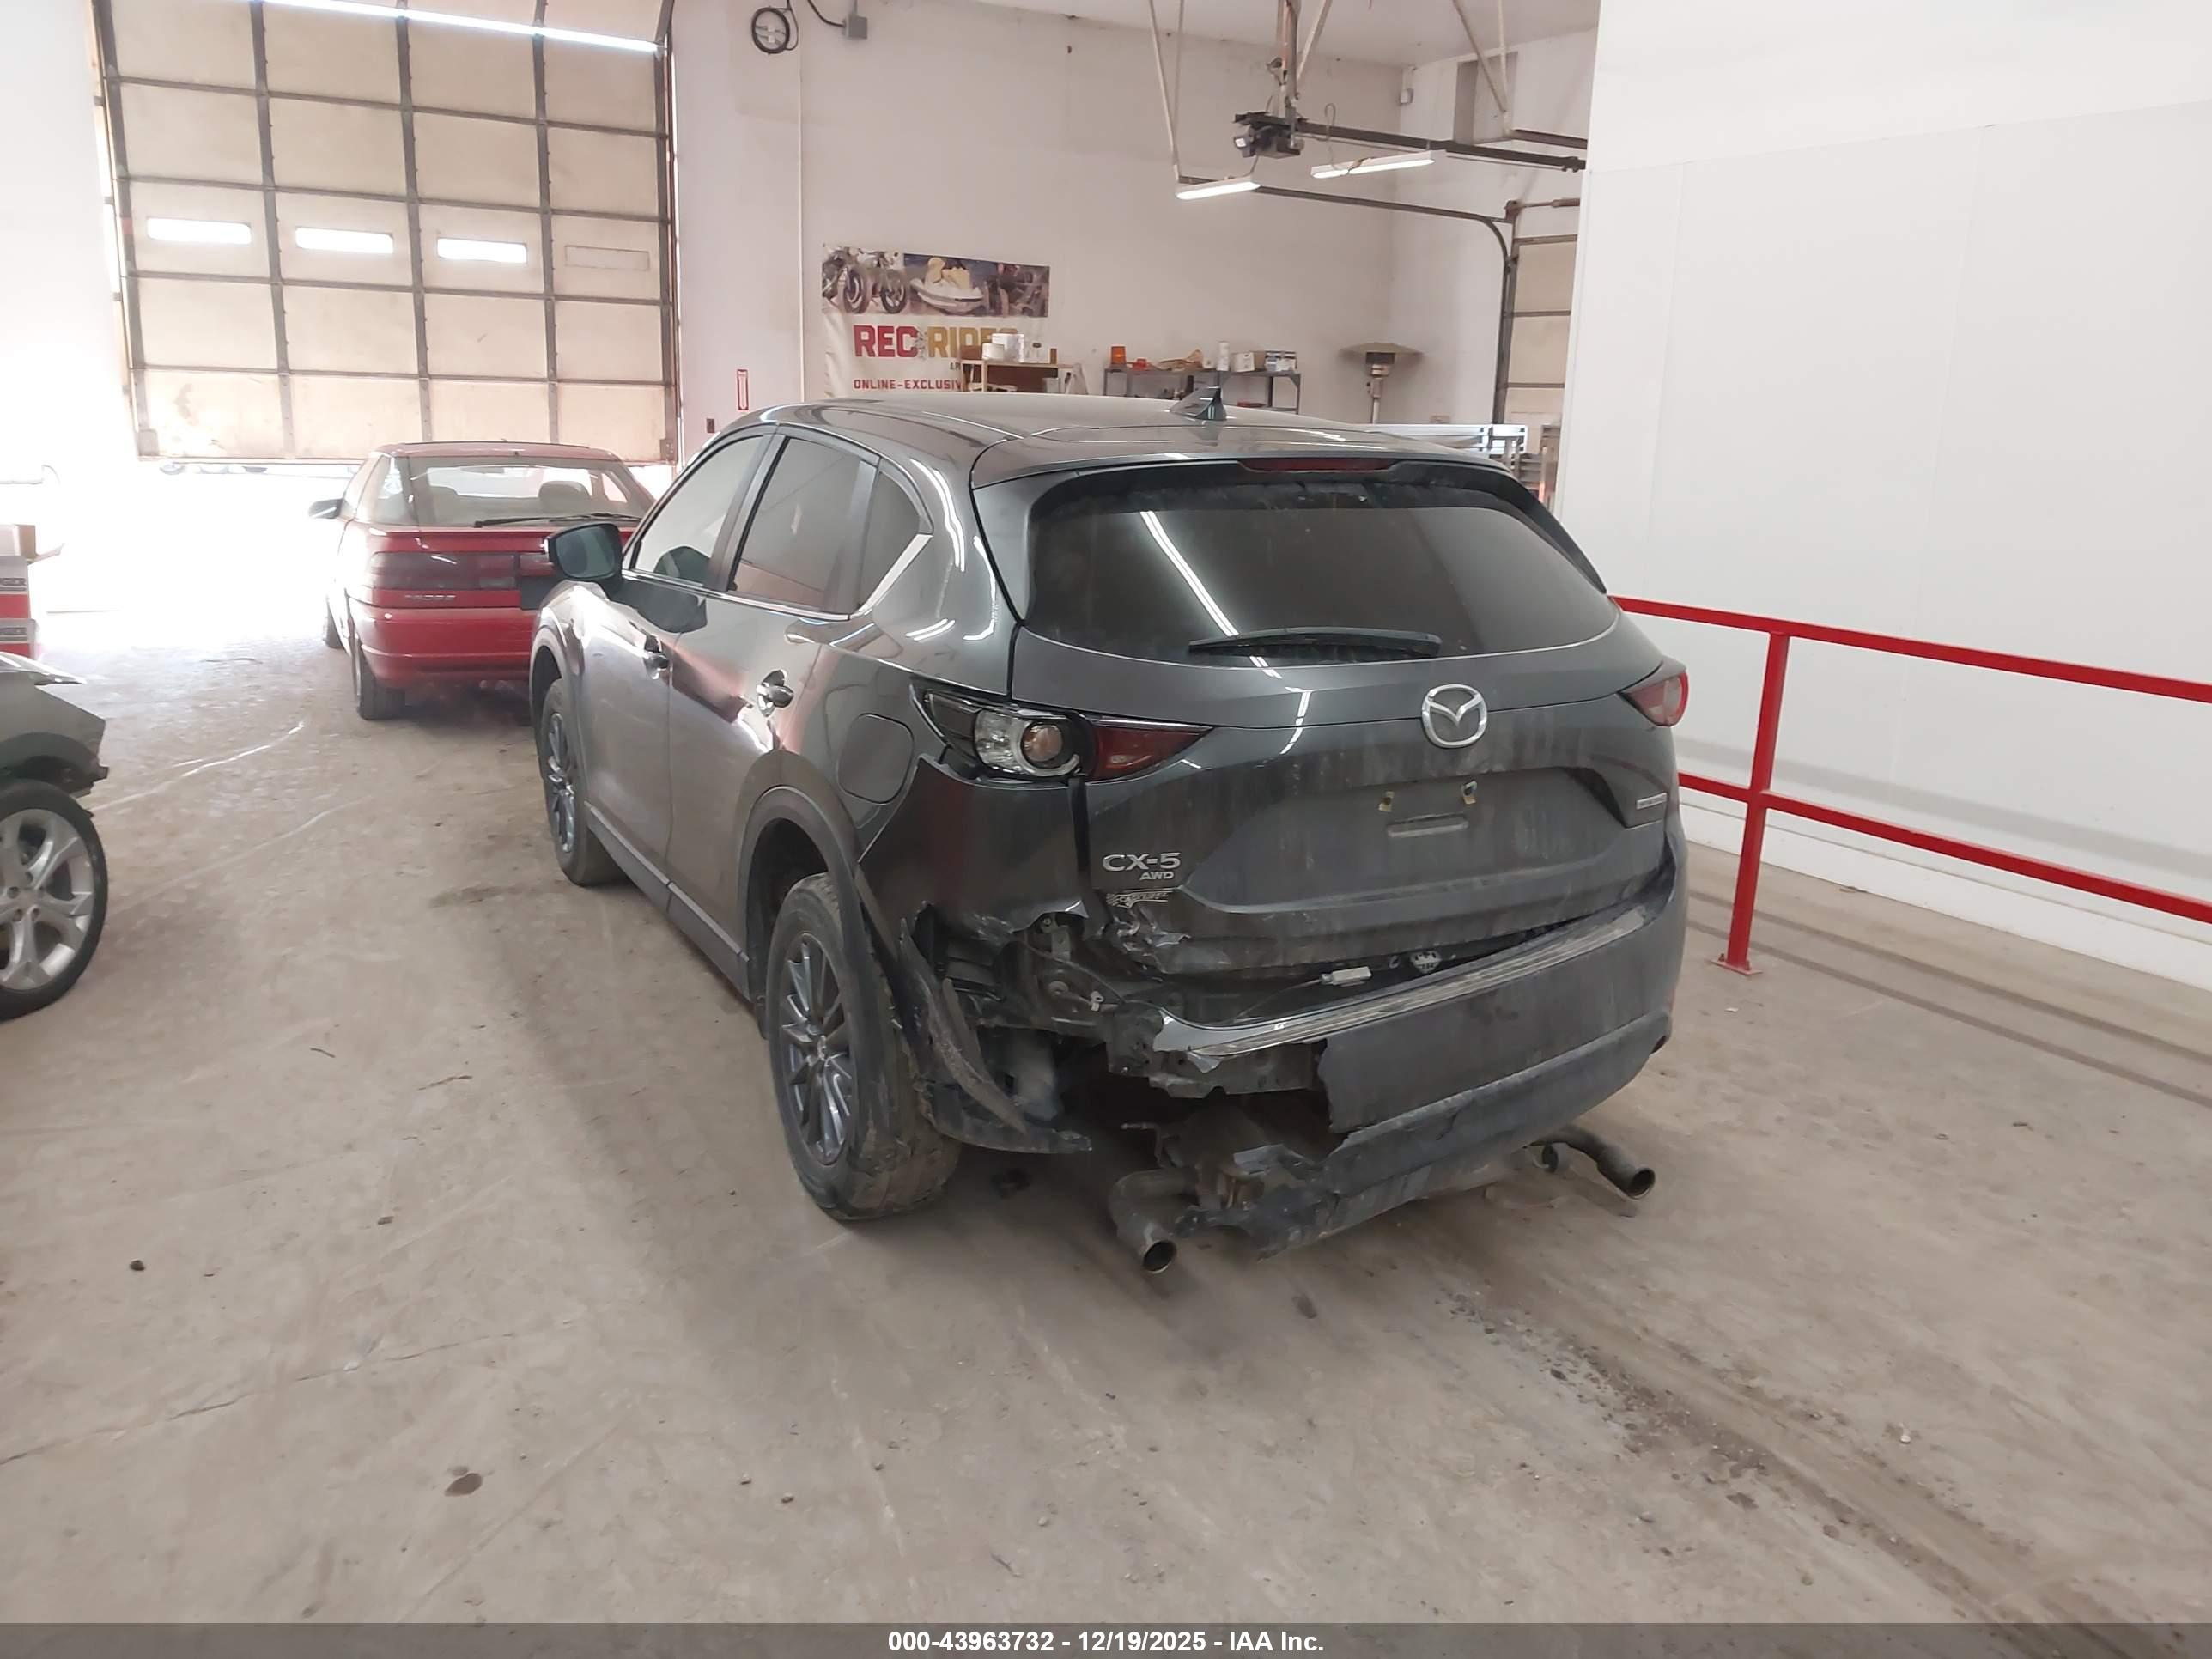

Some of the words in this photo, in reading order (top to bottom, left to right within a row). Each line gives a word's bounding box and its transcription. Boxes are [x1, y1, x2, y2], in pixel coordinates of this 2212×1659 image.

[854, 325, 919, 358] REC
[927, 326, 1018, 358] RIDE
[854, 378, 962, 391] ONLINE-EXCLUSIV
[1103, 852, 1181, 872] CX-5
[1139, 871, 1175, 880] AWD
